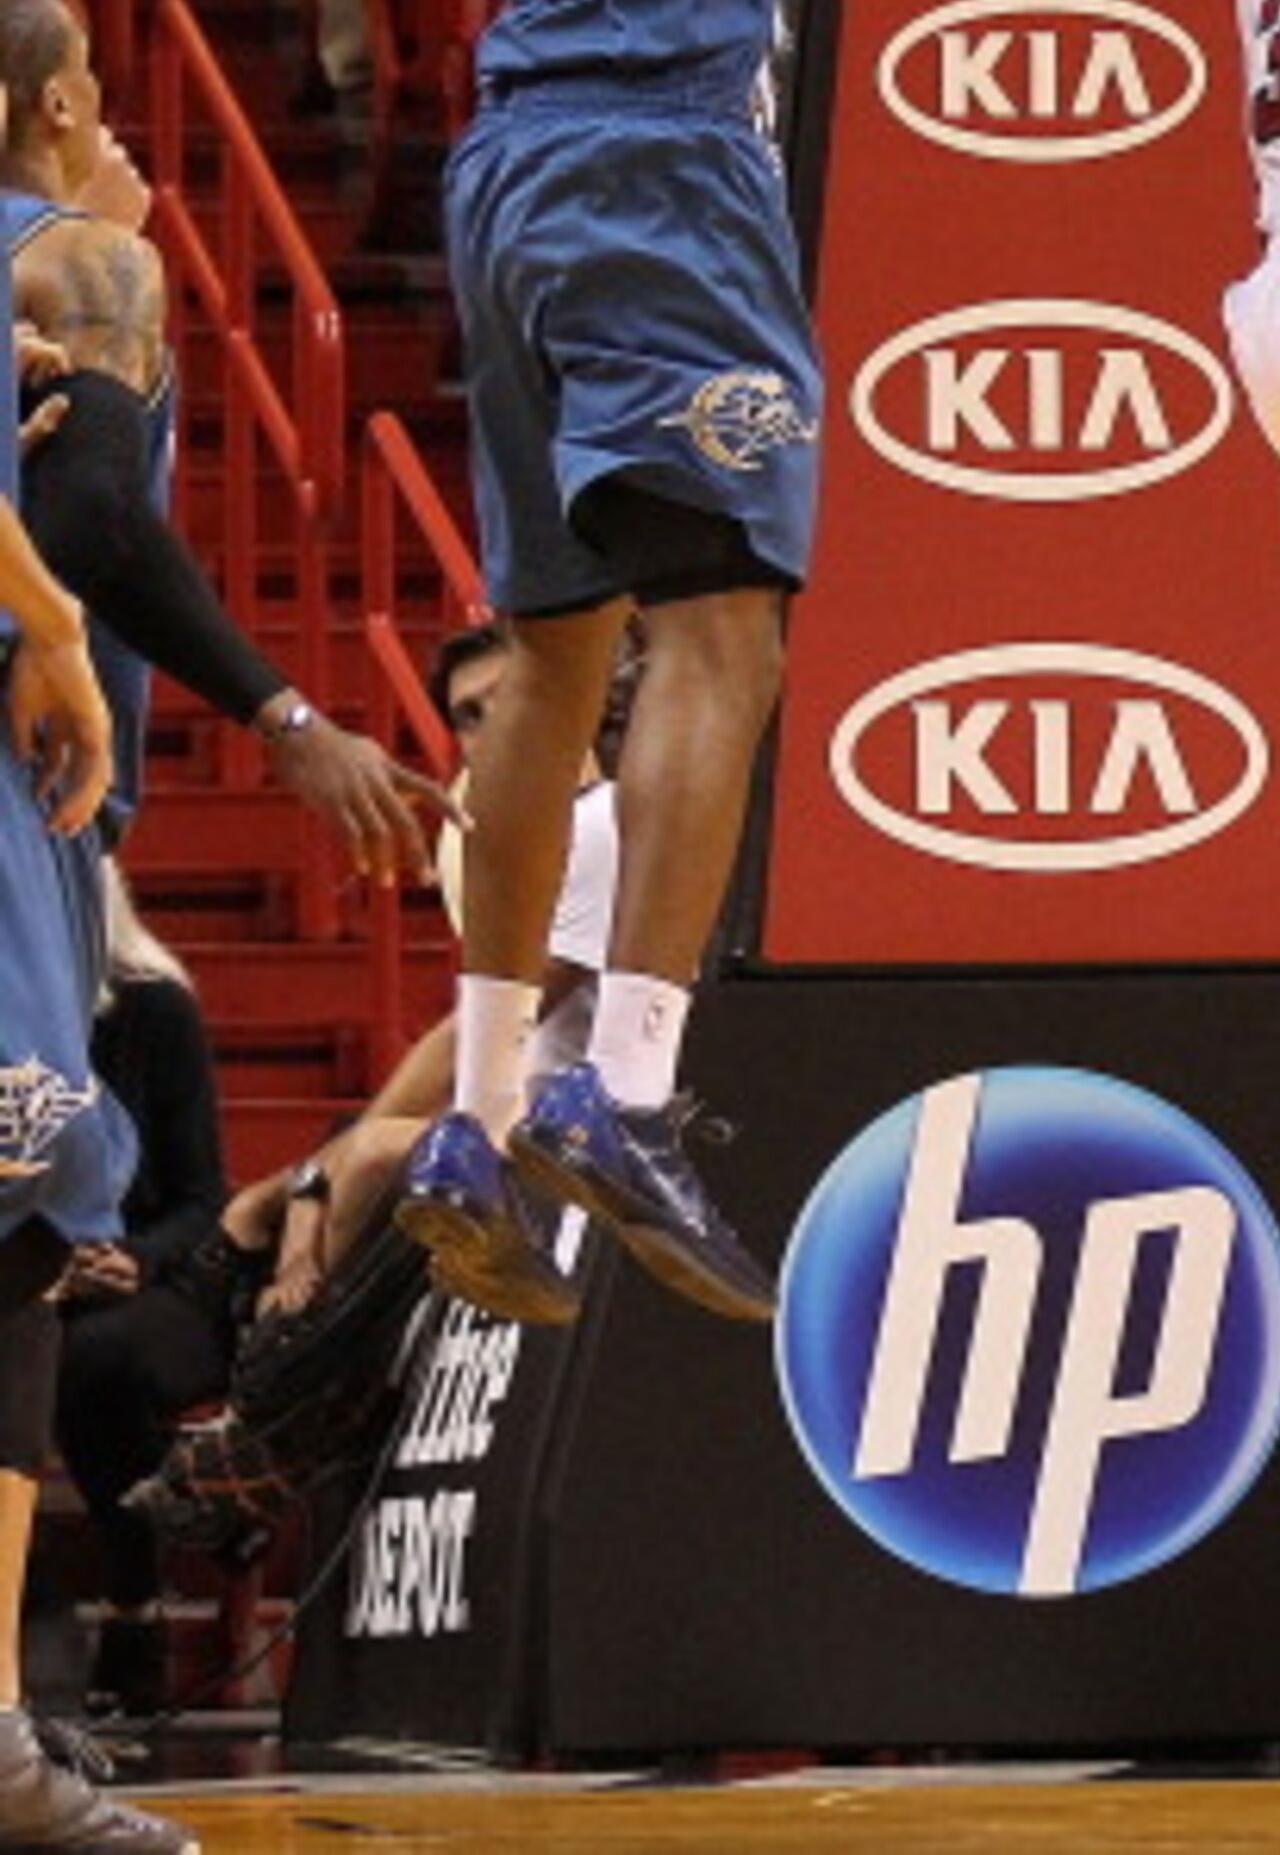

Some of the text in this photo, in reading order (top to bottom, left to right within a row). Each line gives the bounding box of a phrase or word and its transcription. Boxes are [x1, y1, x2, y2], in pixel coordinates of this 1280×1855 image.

[939, 30, 1152, 118] KIA
[922, 348, 1172, 451] KIA
[910, 699, 1199, 814] KIA
[852, 1070, 1240, 1598] hp
